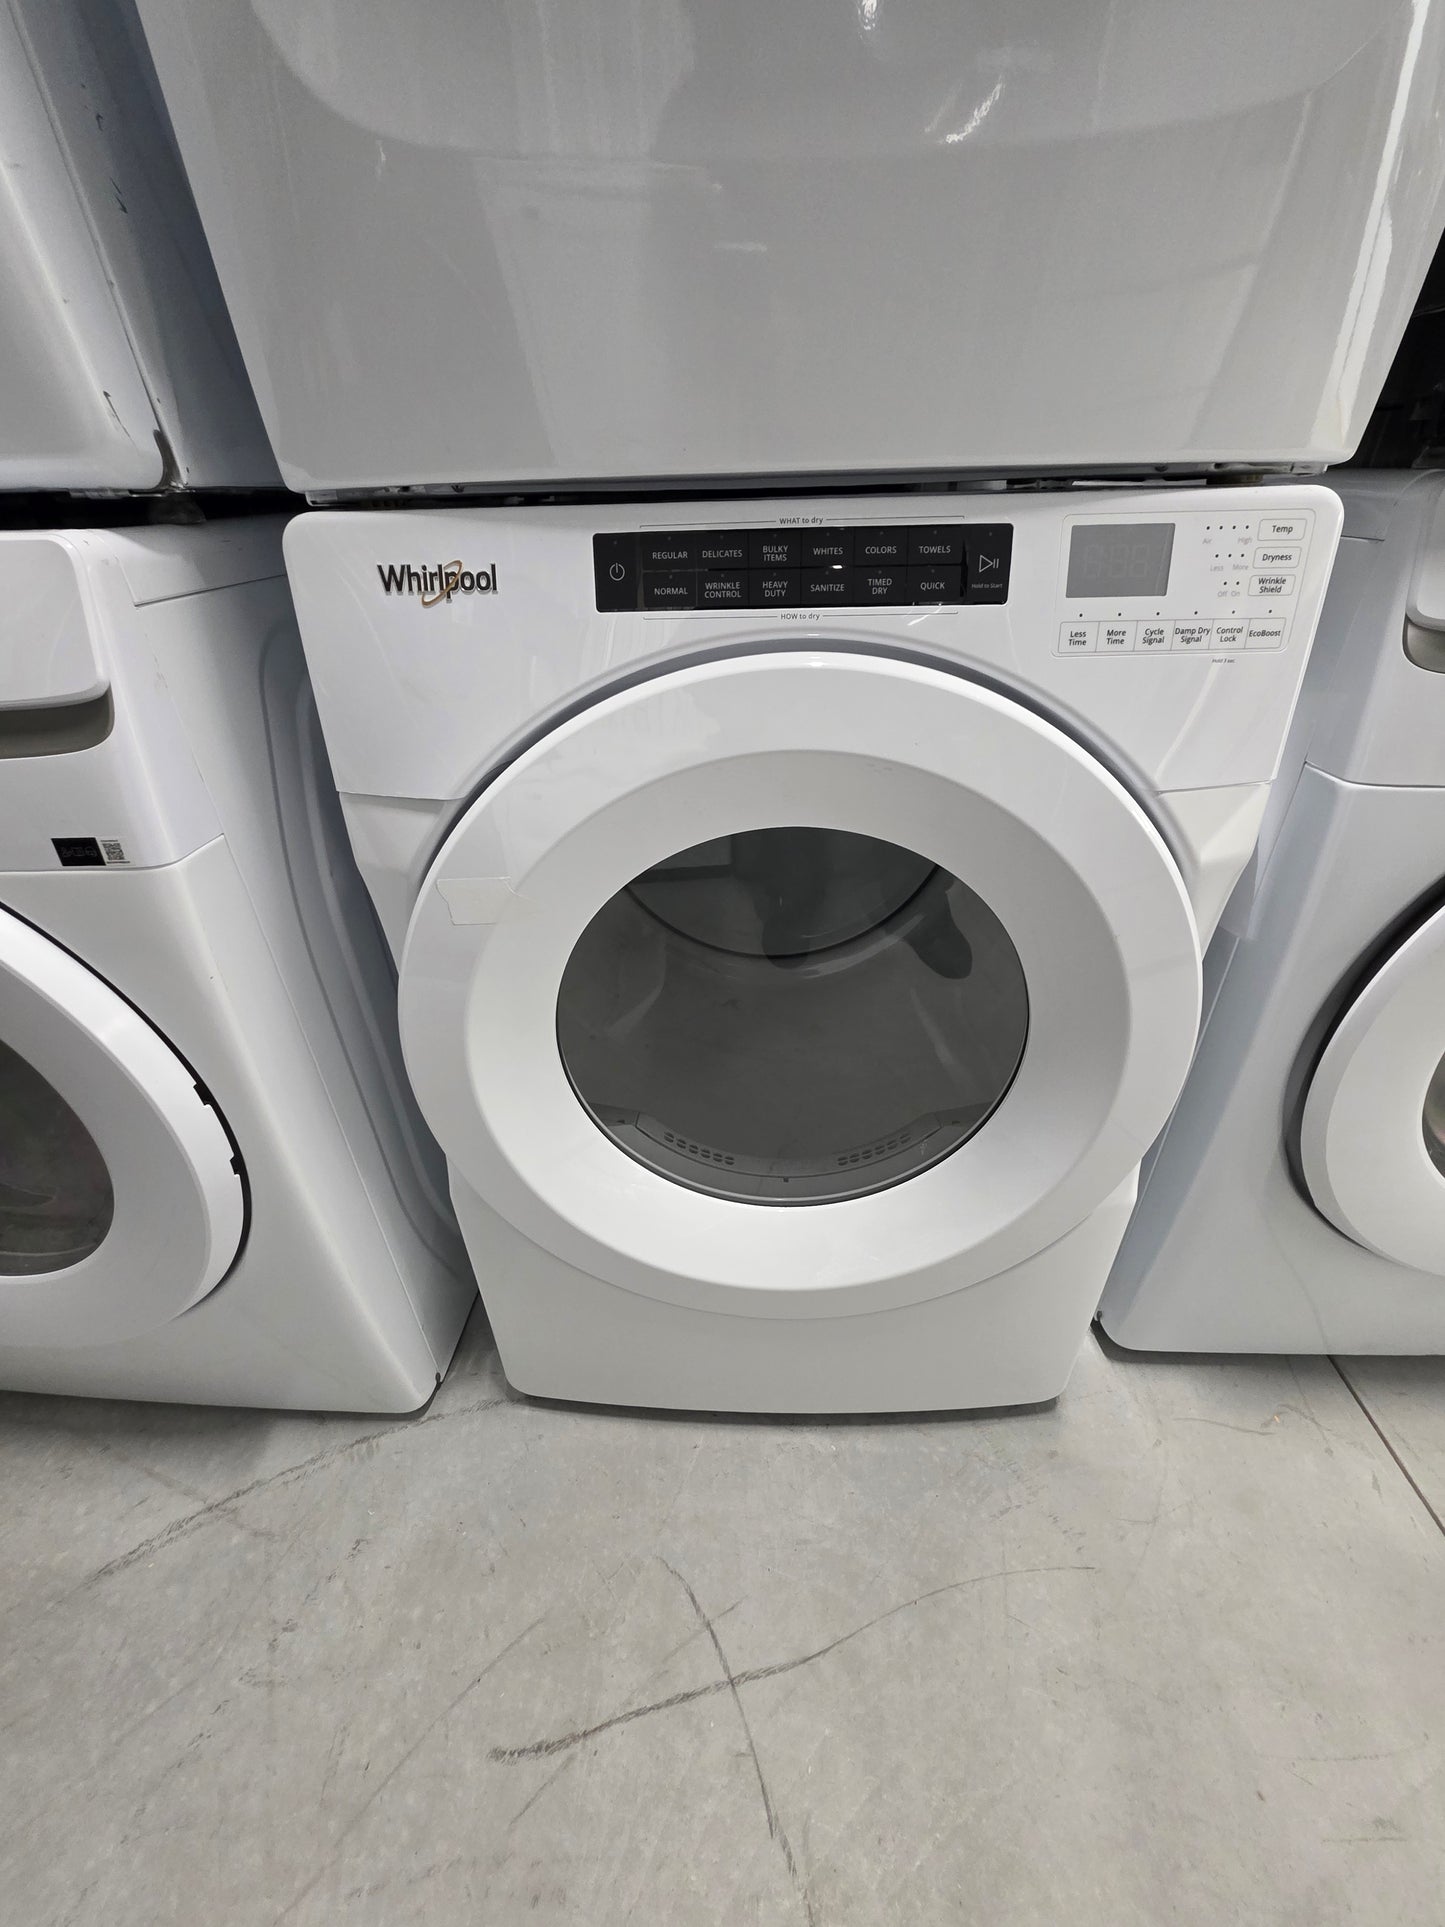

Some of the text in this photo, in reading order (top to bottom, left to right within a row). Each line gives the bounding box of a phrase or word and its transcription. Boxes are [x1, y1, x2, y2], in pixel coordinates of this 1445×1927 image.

[779, 517, 800, 525] WHAT
[811, 516, 824, 524] dry
[1272, 525, 1293, 534] Temp
[762, 545, 788, 553] BULKY
[813, 547, 844, 555] WHITES
[865, 546, 897, 554] COLORS
[919, 546, 951, 554] TOWELS
[652, 551, 688, 560] REGULAR
[702, 550, 742, 558] DELICATES
[764, 554, 788, 562] ITEMS
[1262, 554, 1292, 563] Dryness
[377, 563, 498, 600] Whirlpool
[762, 581, 788, 589] HEAVY
[868, 578, 892, 586] TIMED
[705, 582, 741, 590] WRINKLE
[810, 584, 845, 592] SANITIZE
[920, 582, 945, 590] QUICK
[654, 587, 688, 596] NORMAL
[704, 590, 742, 598] CONTROL
[808, 612, 820, 620] dry
[1144, 628, 1164, 637] Cycle
[1175, 627, 1211, 637] Damp Dry
[1216, 626, 1243, 634] Control
[1249, 629, 1281, 638] EcoBoost
[1142, 636, 1164, 646] Signal
[1180, 635, 1202, 645] Signal
[1220, 635, 1237, 643] Lock
